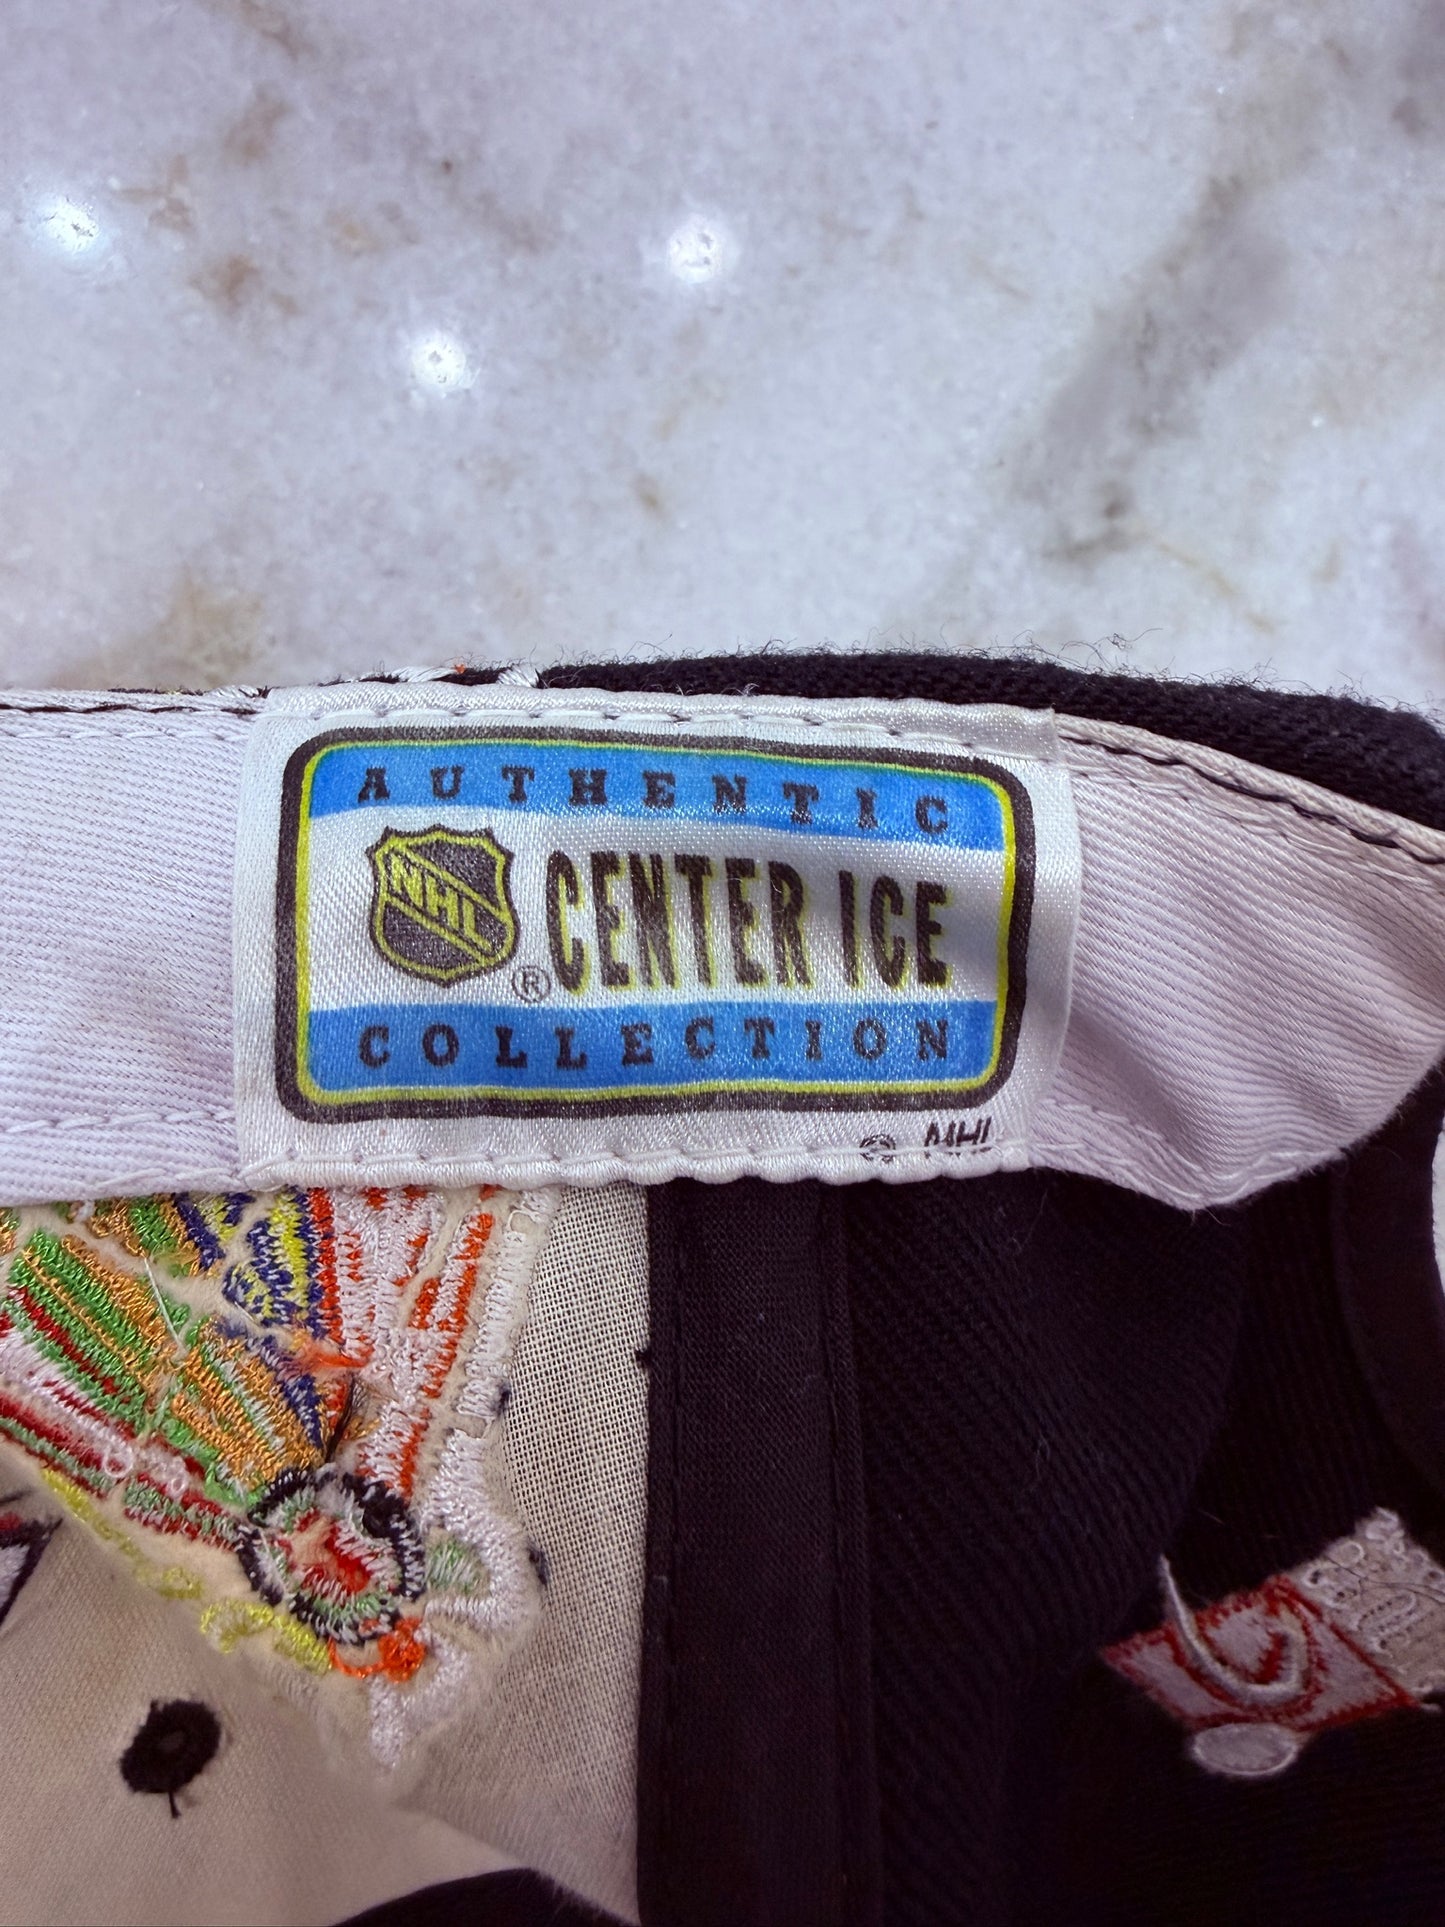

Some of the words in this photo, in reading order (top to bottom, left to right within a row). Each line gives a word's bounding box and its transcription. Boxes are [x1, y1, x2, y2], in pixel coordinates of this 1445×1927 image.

[357, 765, 949, 834] AUTHENTIC
[386, 849, 500, 953] NHL
[546, 849, 814, 995] CENTER
[838, 869, 953, 991] ICE
[358, 1017, 948, 1069] COLLECTION
